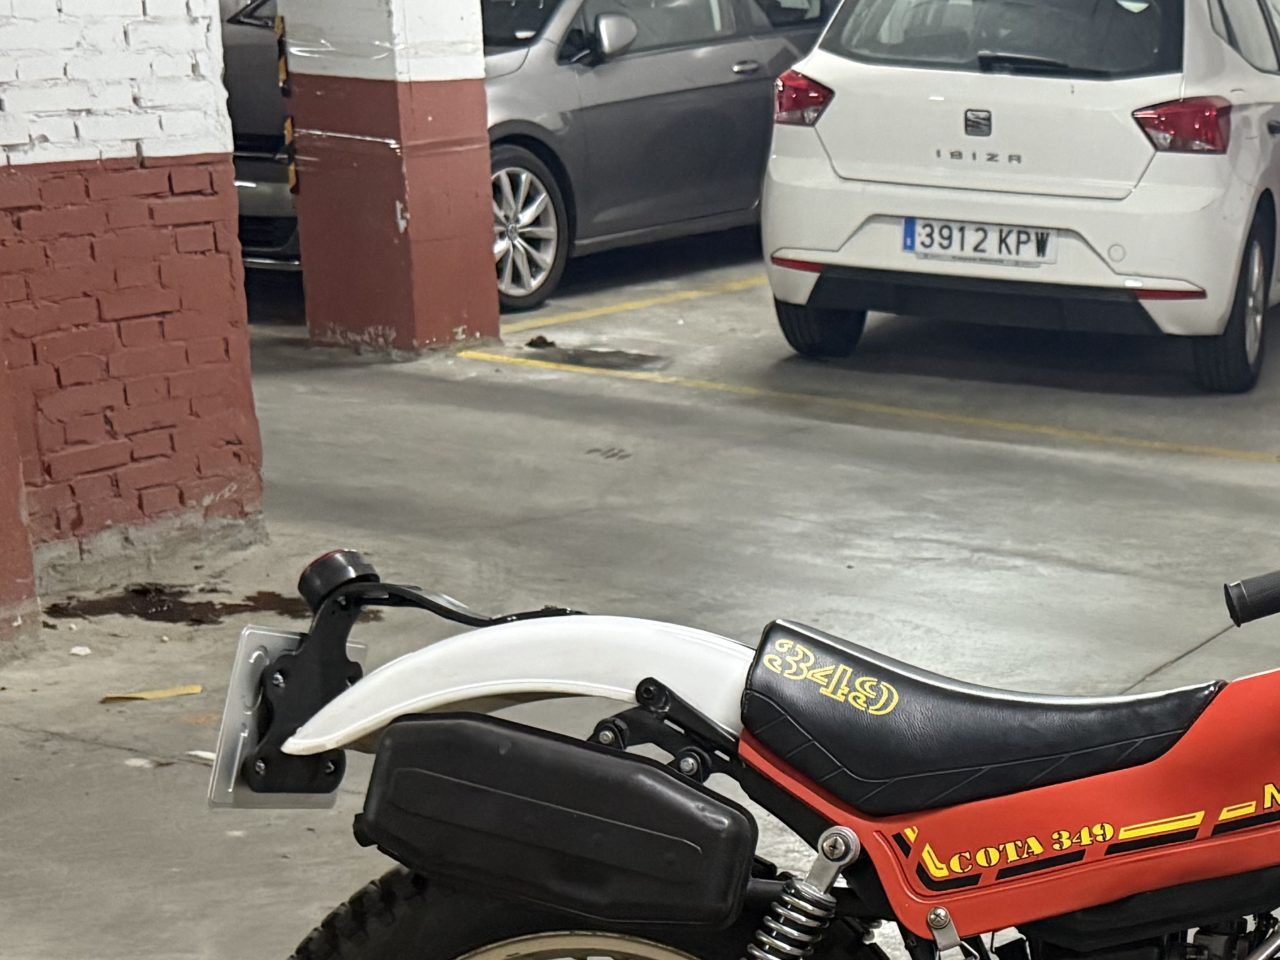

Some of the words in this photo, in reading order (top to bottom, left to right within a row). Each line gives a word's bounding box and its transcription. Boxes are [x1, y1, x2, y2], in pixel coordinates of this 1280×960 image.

[936, 149, 1022, 164] IBIZA
[919, 223, 989, 253] 3912
[998, 228, 1050, 258] KPW
[763, 639, 899, 716] 349
[949, 836, 1045, 874] COTA
[1051, 822, 1115, 852] 349
